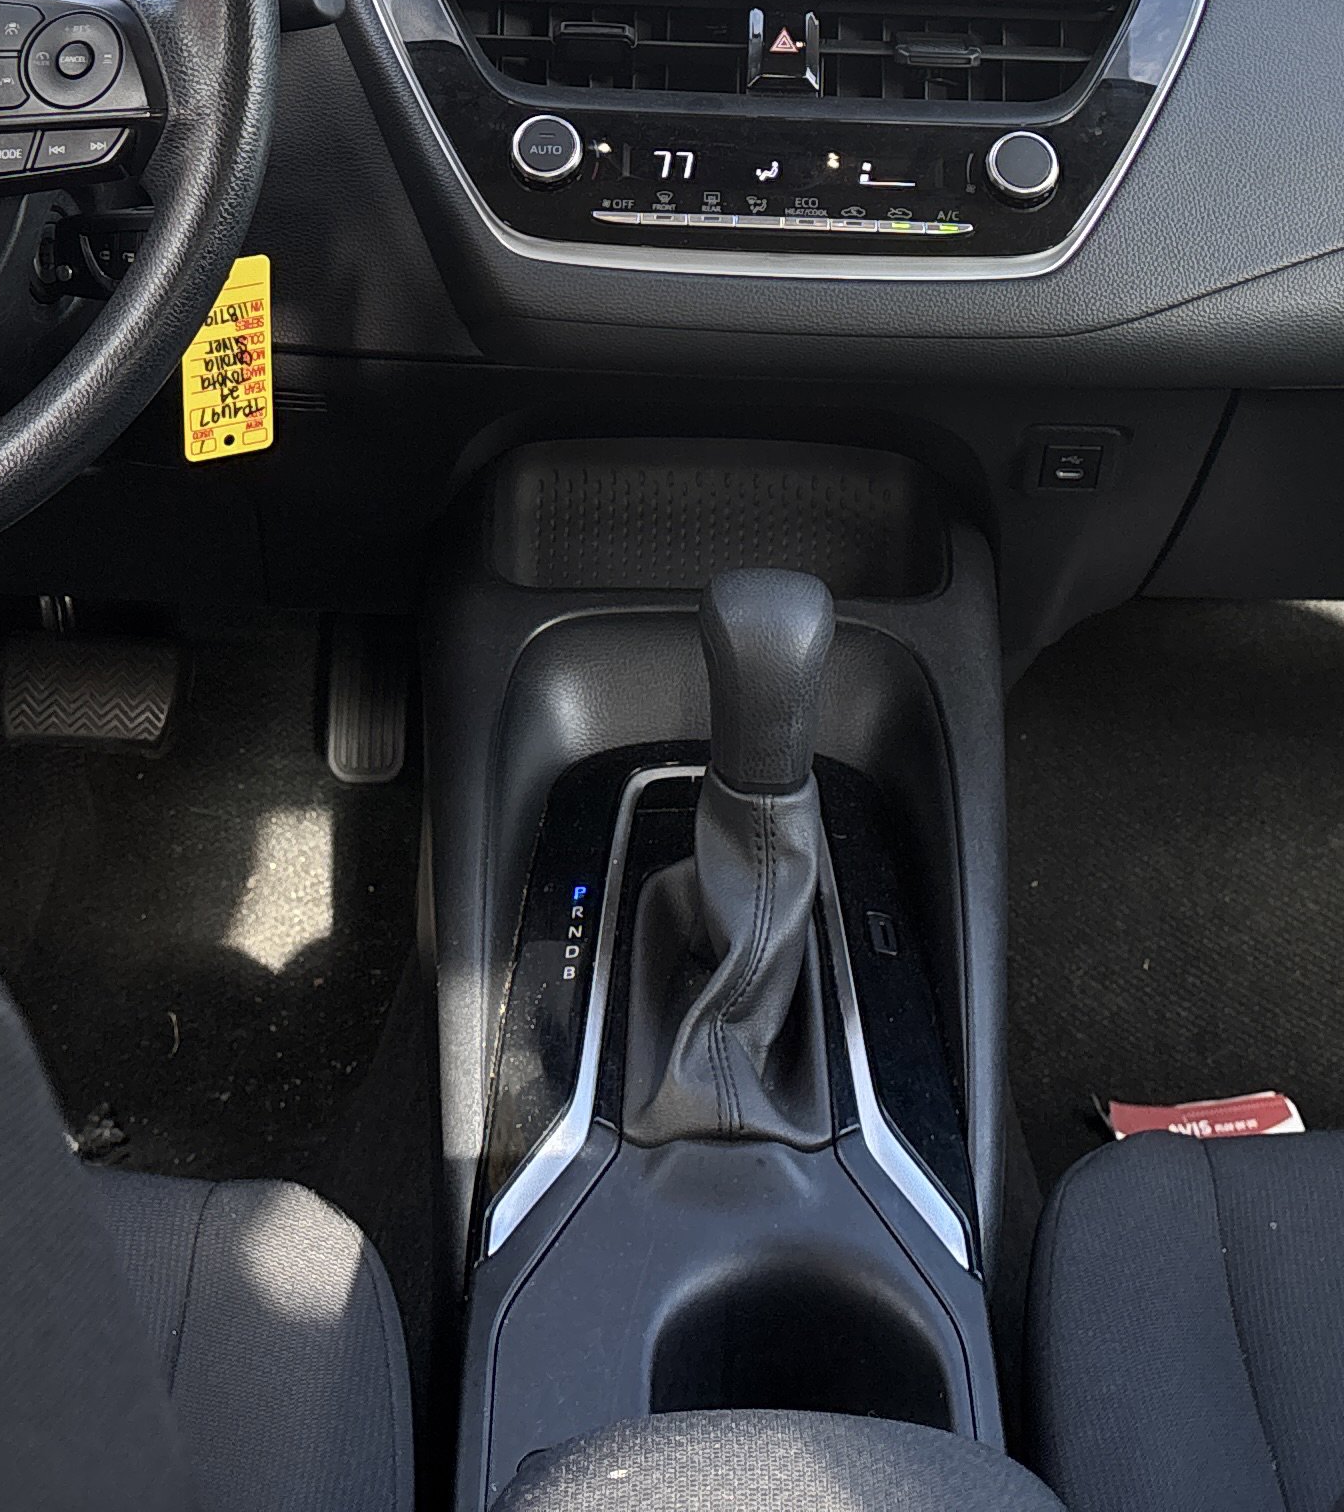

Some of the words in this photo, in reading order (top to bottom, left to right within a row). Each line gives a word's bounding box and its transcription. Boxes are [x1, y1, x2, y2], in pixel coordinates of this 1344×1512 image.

[529, 144, 562, 155] AUTO
[653, 150, 695, 179] 77
[612, 199, 635, 209] OFF
[652, 203, 677, 211] FRONT
[702, 205, 722, 213] REAR
[795, 197, 819, 208] ECO
[937, 210, 960, 221] A/C
[250, 302, 264, 314] VIN
[235, 316, 265, 332] SERIES
[205, 335, 248, 355] Silver
[204, 349, 252, 372] Corolla
[201, 367, 252, 390] Toyota
[244, 381, 266, 396] YEAR
[192, 428, 214, 440] USED
[573, 886, 587, 900] P
[571, 906, 584, 919] R
[568, 925, 582, 939] N
[565, 945, 580, 959] D
[563, 966, 576, 980] B
